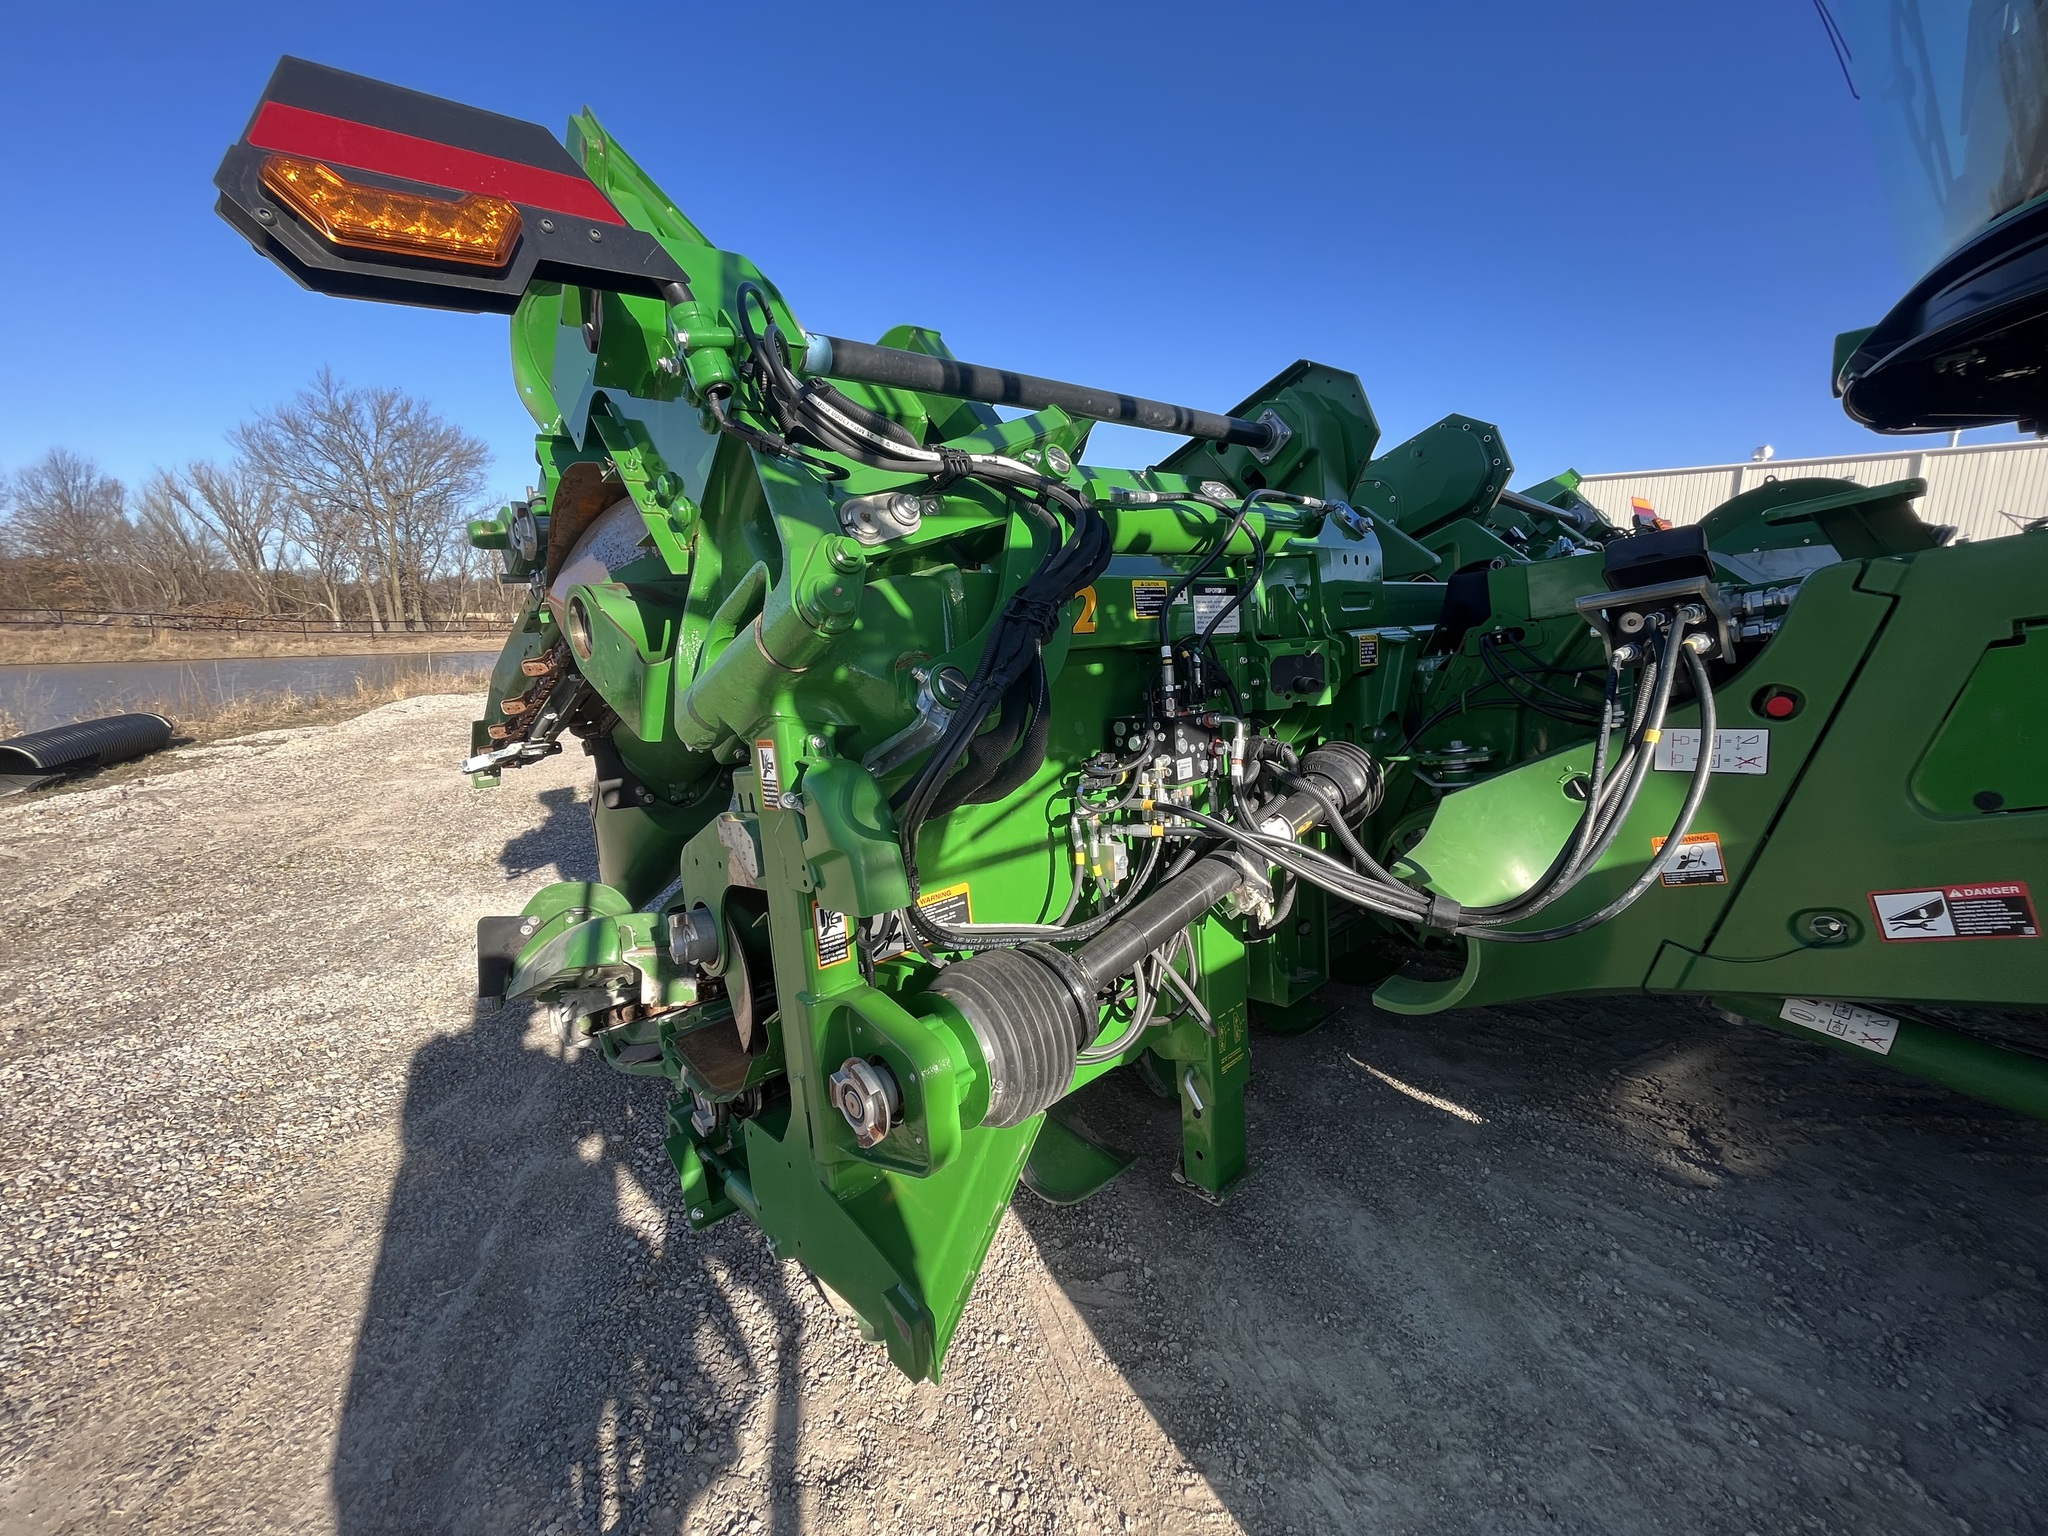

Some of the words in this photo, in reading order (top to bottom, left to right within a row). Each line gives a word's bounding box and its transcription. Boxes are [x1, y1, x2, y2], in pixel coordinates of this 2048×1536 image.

[1072, 585, 1097, 635] 2
[919, 889, 952, 905] WARNING
[1963, 885, 2020, 897] DANGER
